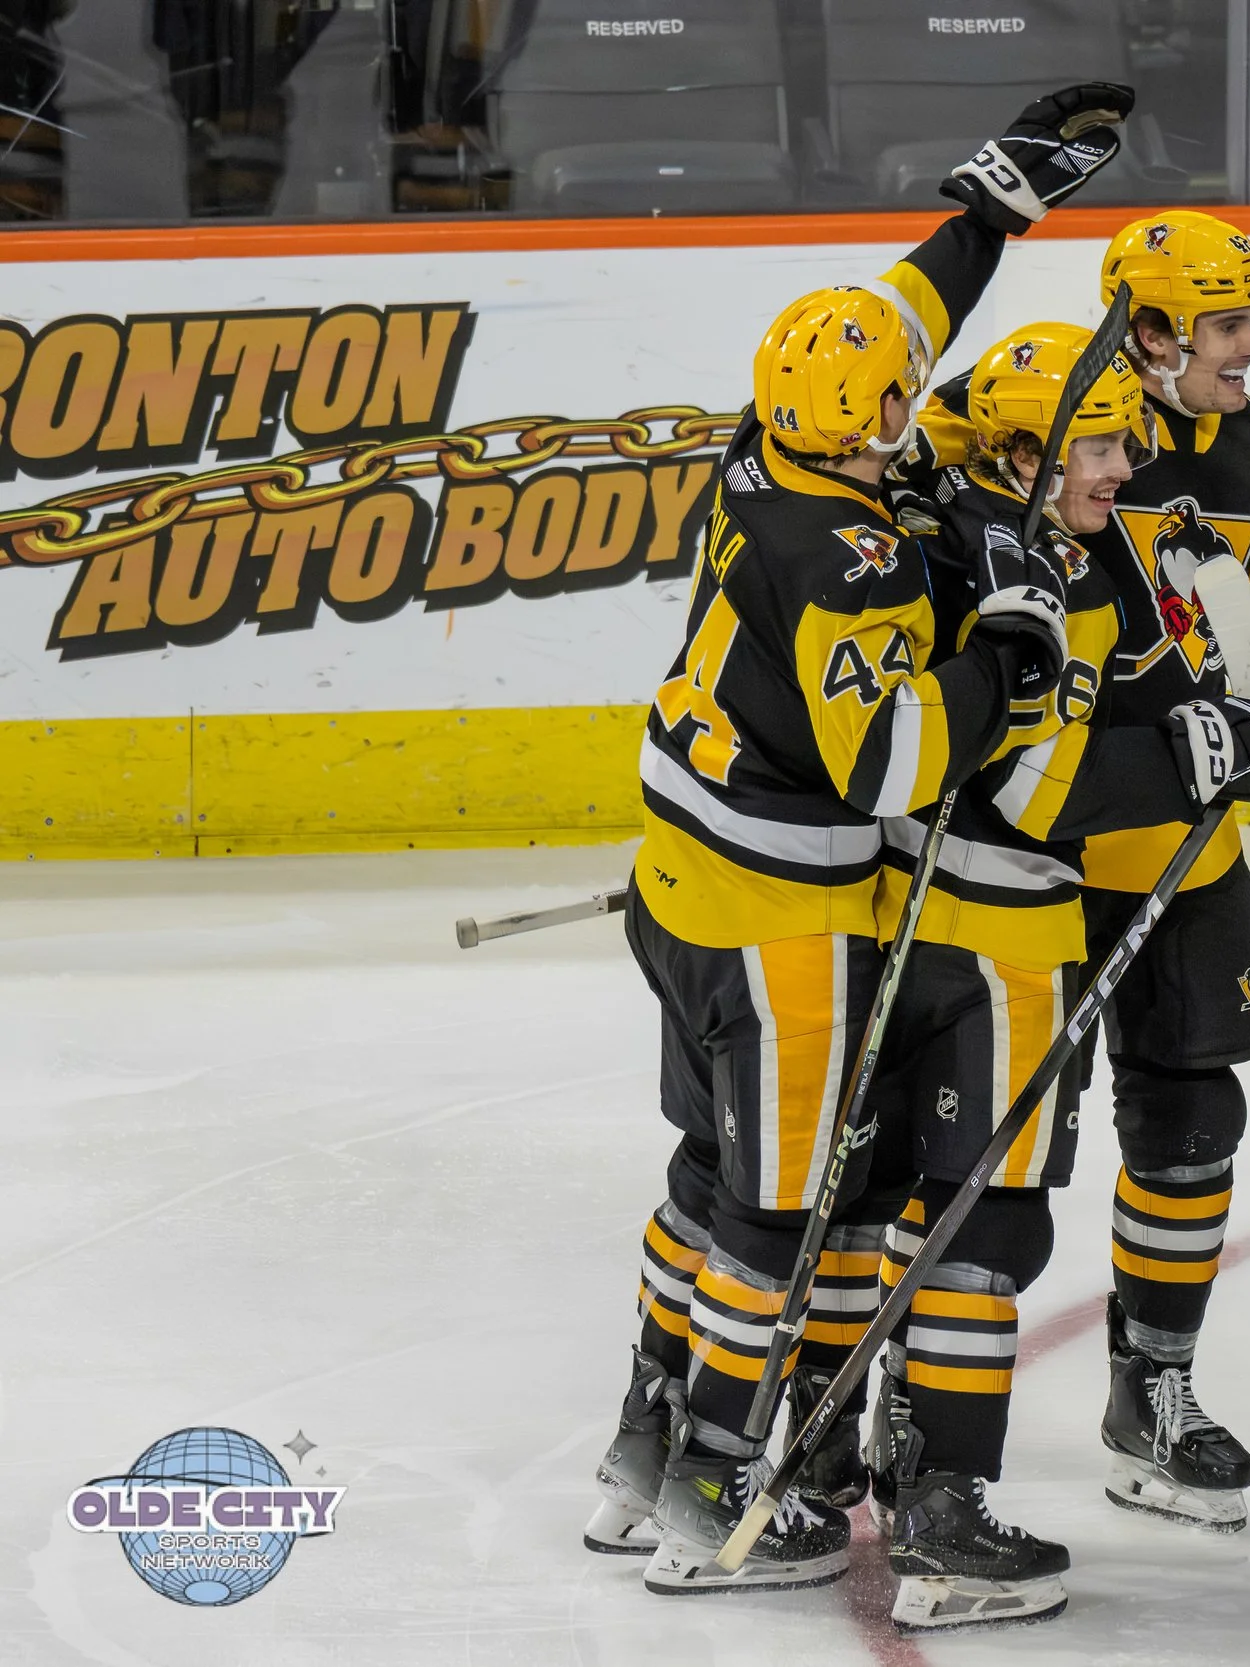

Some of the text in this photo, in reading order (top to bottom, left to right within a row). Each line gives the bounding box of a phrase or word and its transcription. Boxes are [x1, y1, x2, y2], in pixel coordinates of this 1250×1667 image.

[587, 19, 684, 36] RESERVED
[928, 17, 1025, 33] RESERVED
[1073, 142, 1105, 155] CCM
[971, 149, 1022, 193] CC
[773, 405, 800, 432] 44
[744, 456, 772, 490] CCM
[946, 466, 970, 491] CCM
[56, 460, 716, 641] AUTO BODY
[822, 628, 916, 708] 44
[1066, 892, 1165, 1046] CCM
[818, 1123, 856, 1222] CCM
[728, 1518, 784, 1549] BER
